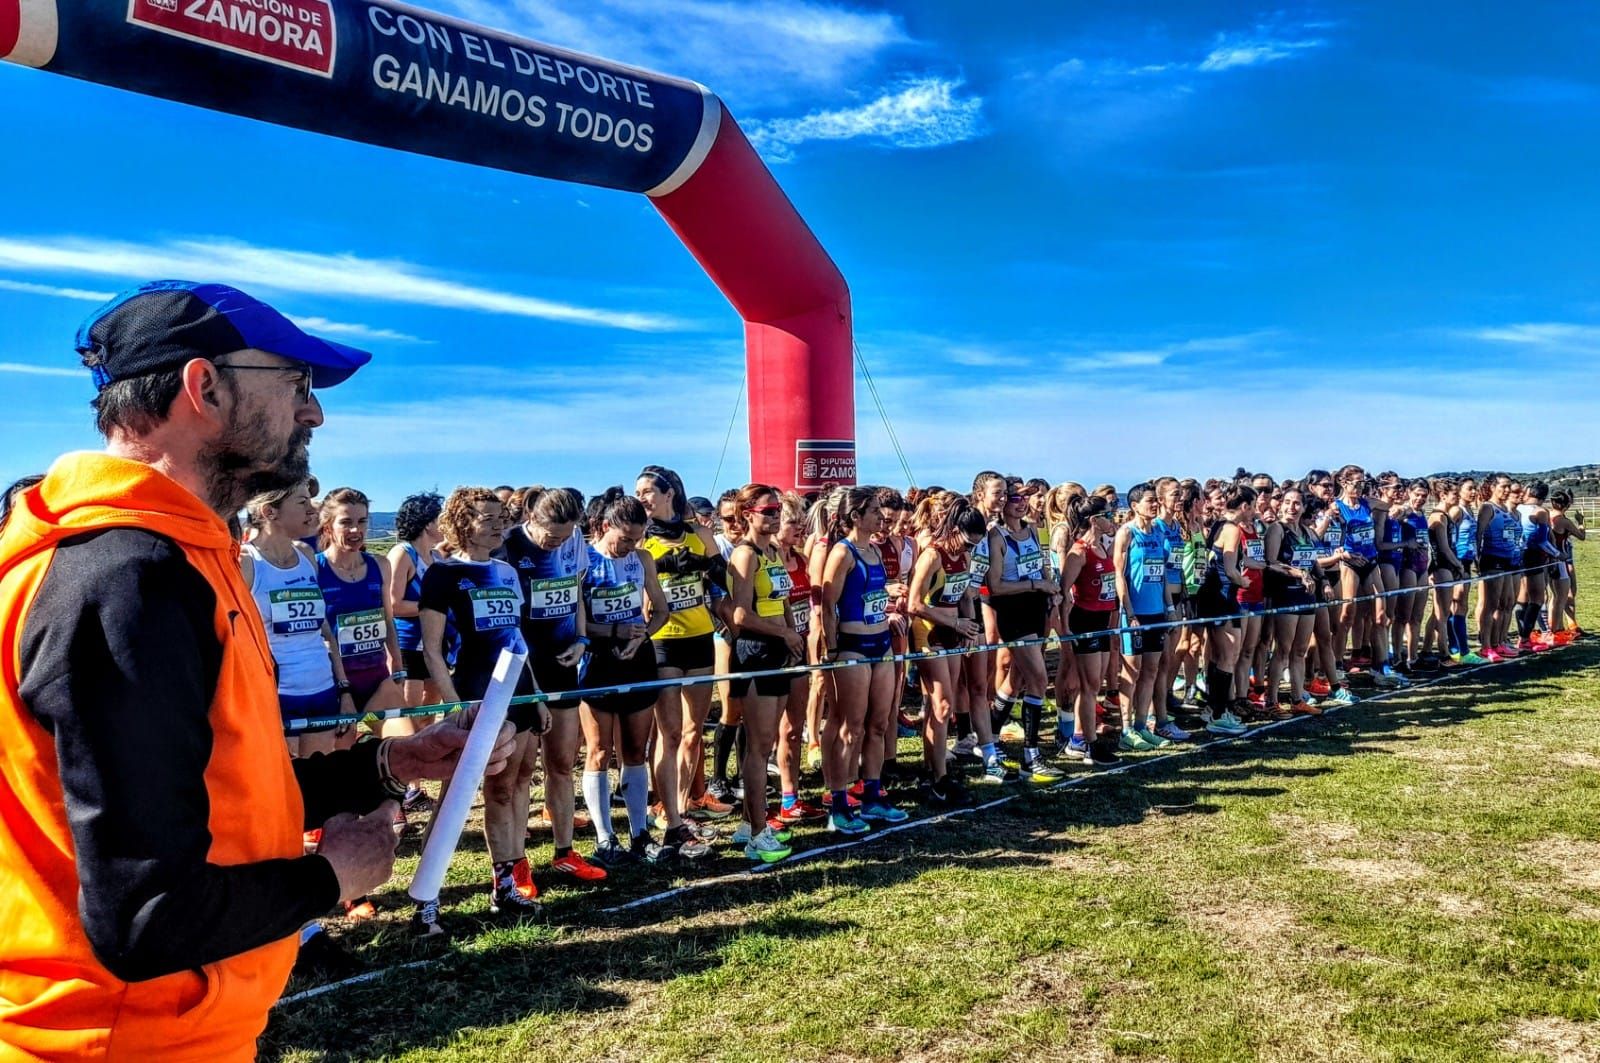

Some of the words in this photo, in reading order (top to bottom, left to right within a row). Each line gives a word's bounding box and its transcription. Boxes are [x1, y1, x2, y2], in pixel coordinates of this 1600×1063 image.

[298, 8, 323, 27] DE
[183, 0, 324, 56] ZAMORA
[368, 6, 453, 54] CON
[459, 31, 506, 69] EL
[509, 46, 655, 109] DEPORTE
[373, 53, 548, 128] GANAMOS
[555, 101, 655, 152] TODOS
[544, 589, 571, 606] 528
[671, 584, 696, 600] 556
[287, 601, 316, 619] 522
[486, 599, 514, 614] 529
[604, 595, 632, 612] 526
[353, 623, 380, 641] 656
